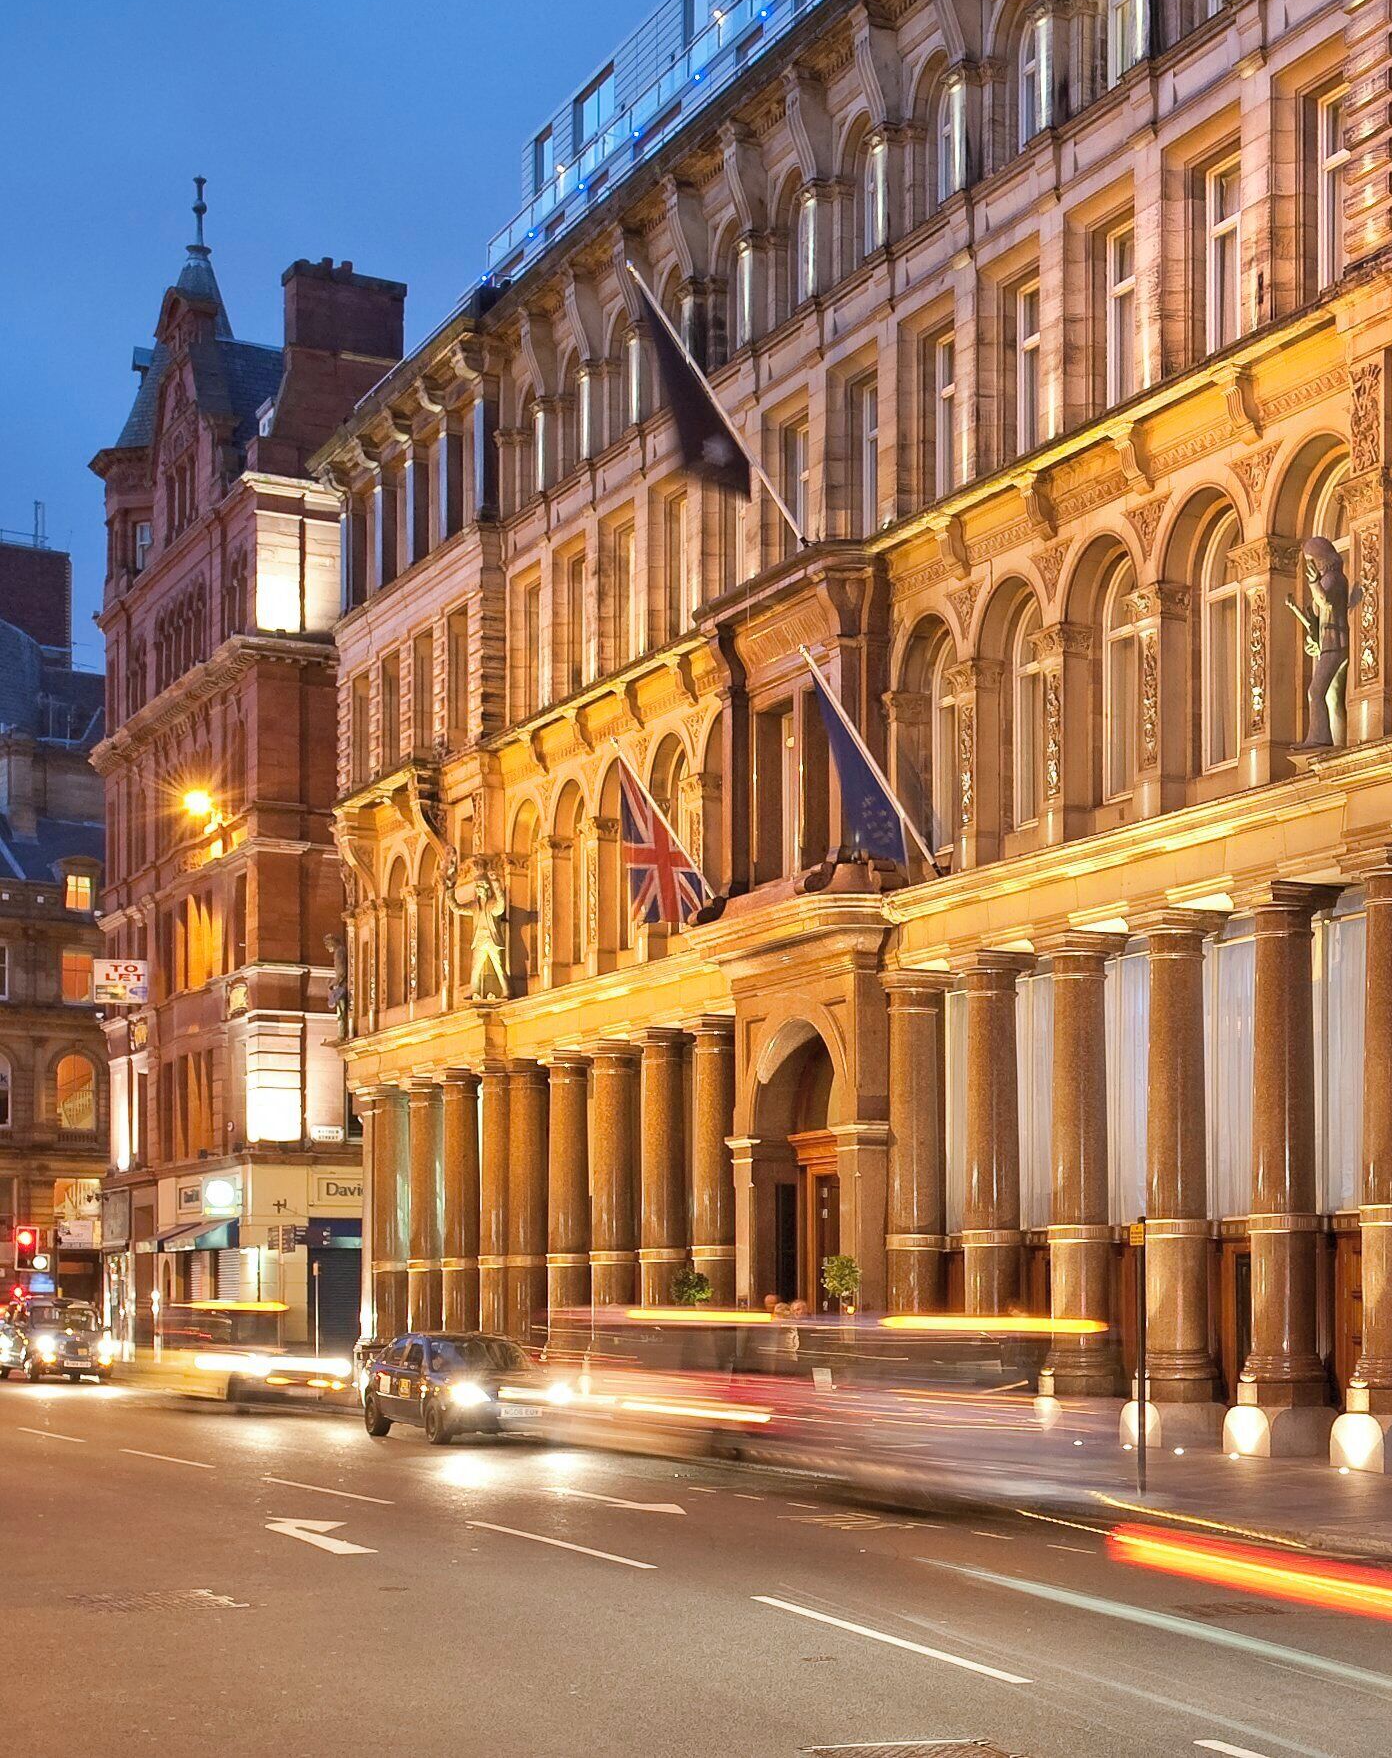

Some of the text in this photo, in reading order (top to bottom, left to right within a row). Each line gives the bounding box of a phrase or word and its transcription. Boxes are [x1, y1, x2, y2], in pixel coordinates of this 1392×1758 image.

[109, 964, 138, 973] TO
[105, 973, 145, 982] LET
[326, 1182, 364, 1197] Davi
